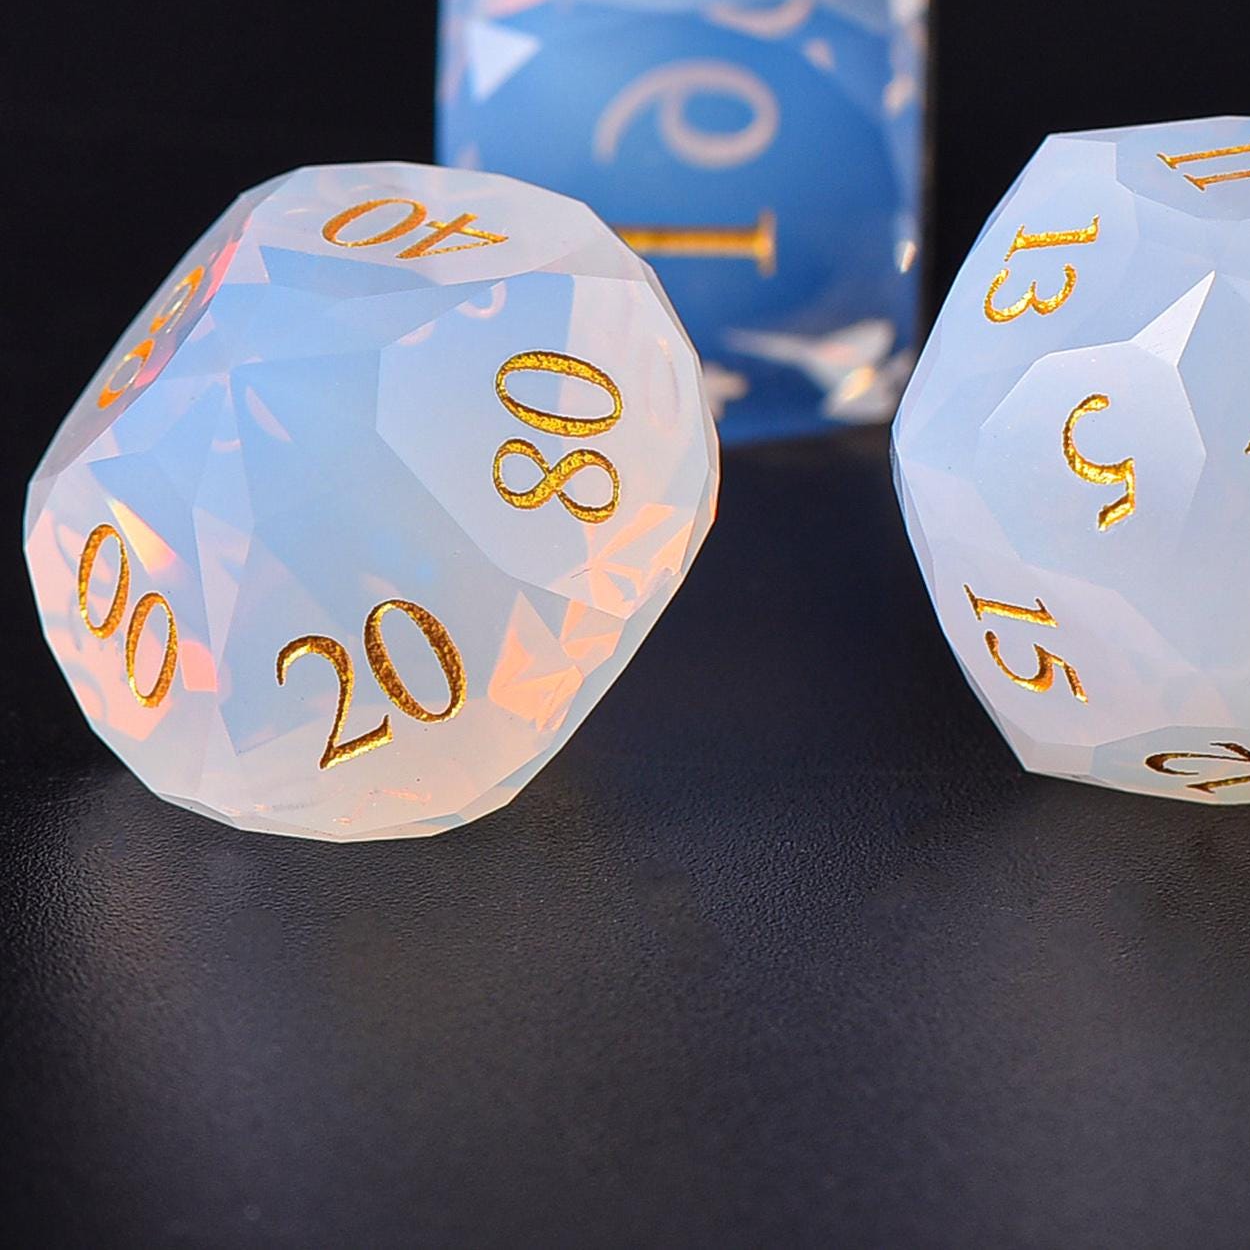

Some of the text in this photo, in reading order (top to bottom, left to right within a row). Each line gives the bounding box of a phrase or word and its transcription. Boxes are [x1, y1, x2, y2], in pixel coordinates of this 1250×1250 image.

[322, 198, 508, 259] 40
[981, 215, 1101, 324] 13
[492, 350, 624, 524] 80
[1061, 393, 1137, 532] 5
[275, 598, 467, 771] 20
[962, 582, 1090, 704] 15
